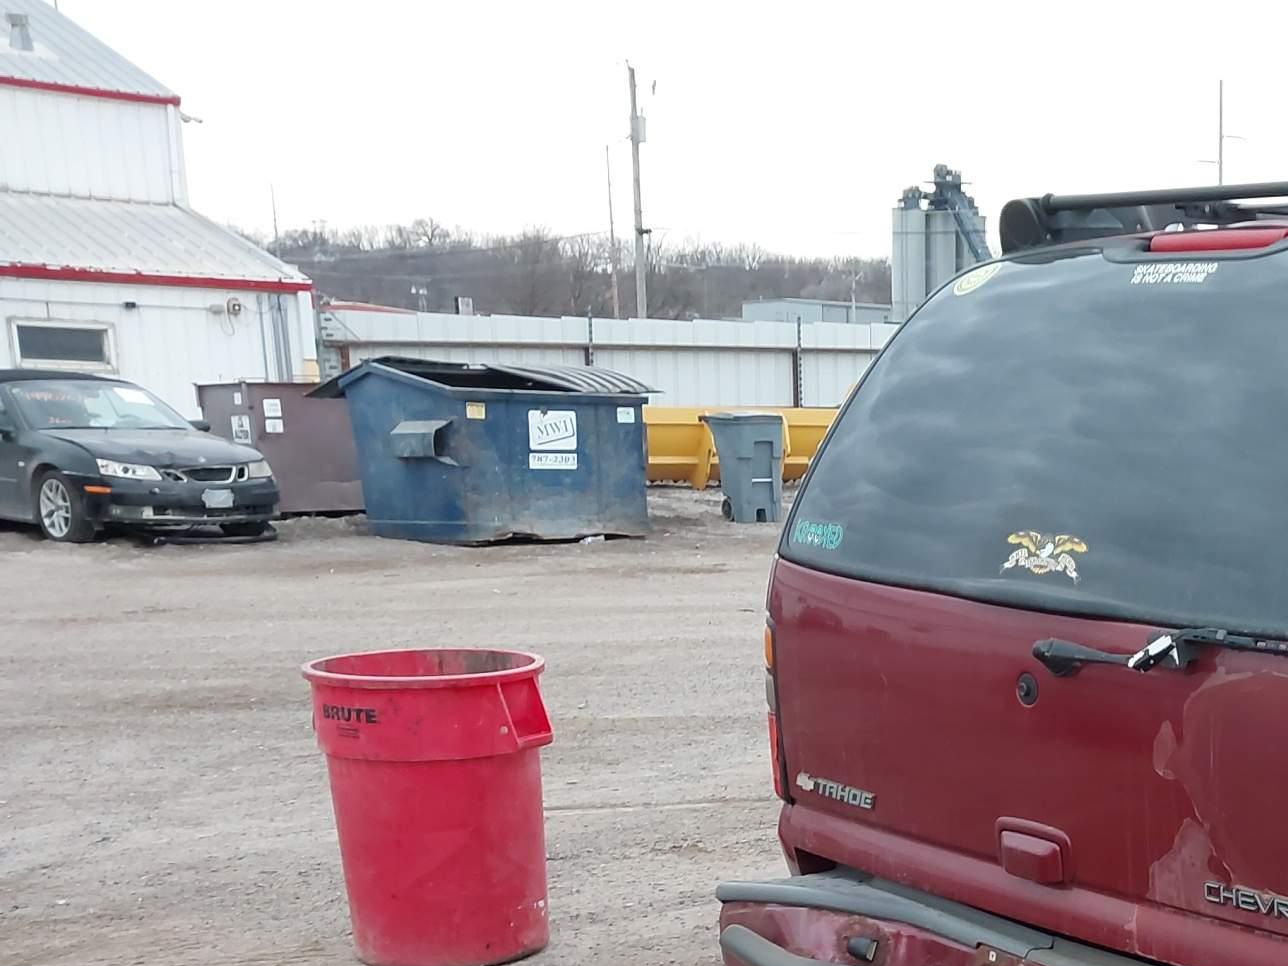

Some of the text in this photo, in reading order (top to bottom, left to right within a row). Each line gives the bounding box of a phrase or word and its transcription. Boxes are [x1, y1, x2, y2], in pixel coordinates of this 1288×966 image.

[1136, 262, 1218, 273] SKATEBOARDING
[1142, 273, 1165, 283] NOT
[1173, 272, 1207, 283] CRIME
[322, 704, 377, 724] BRUTE
[815, 778, 876, 809] TAHOE
